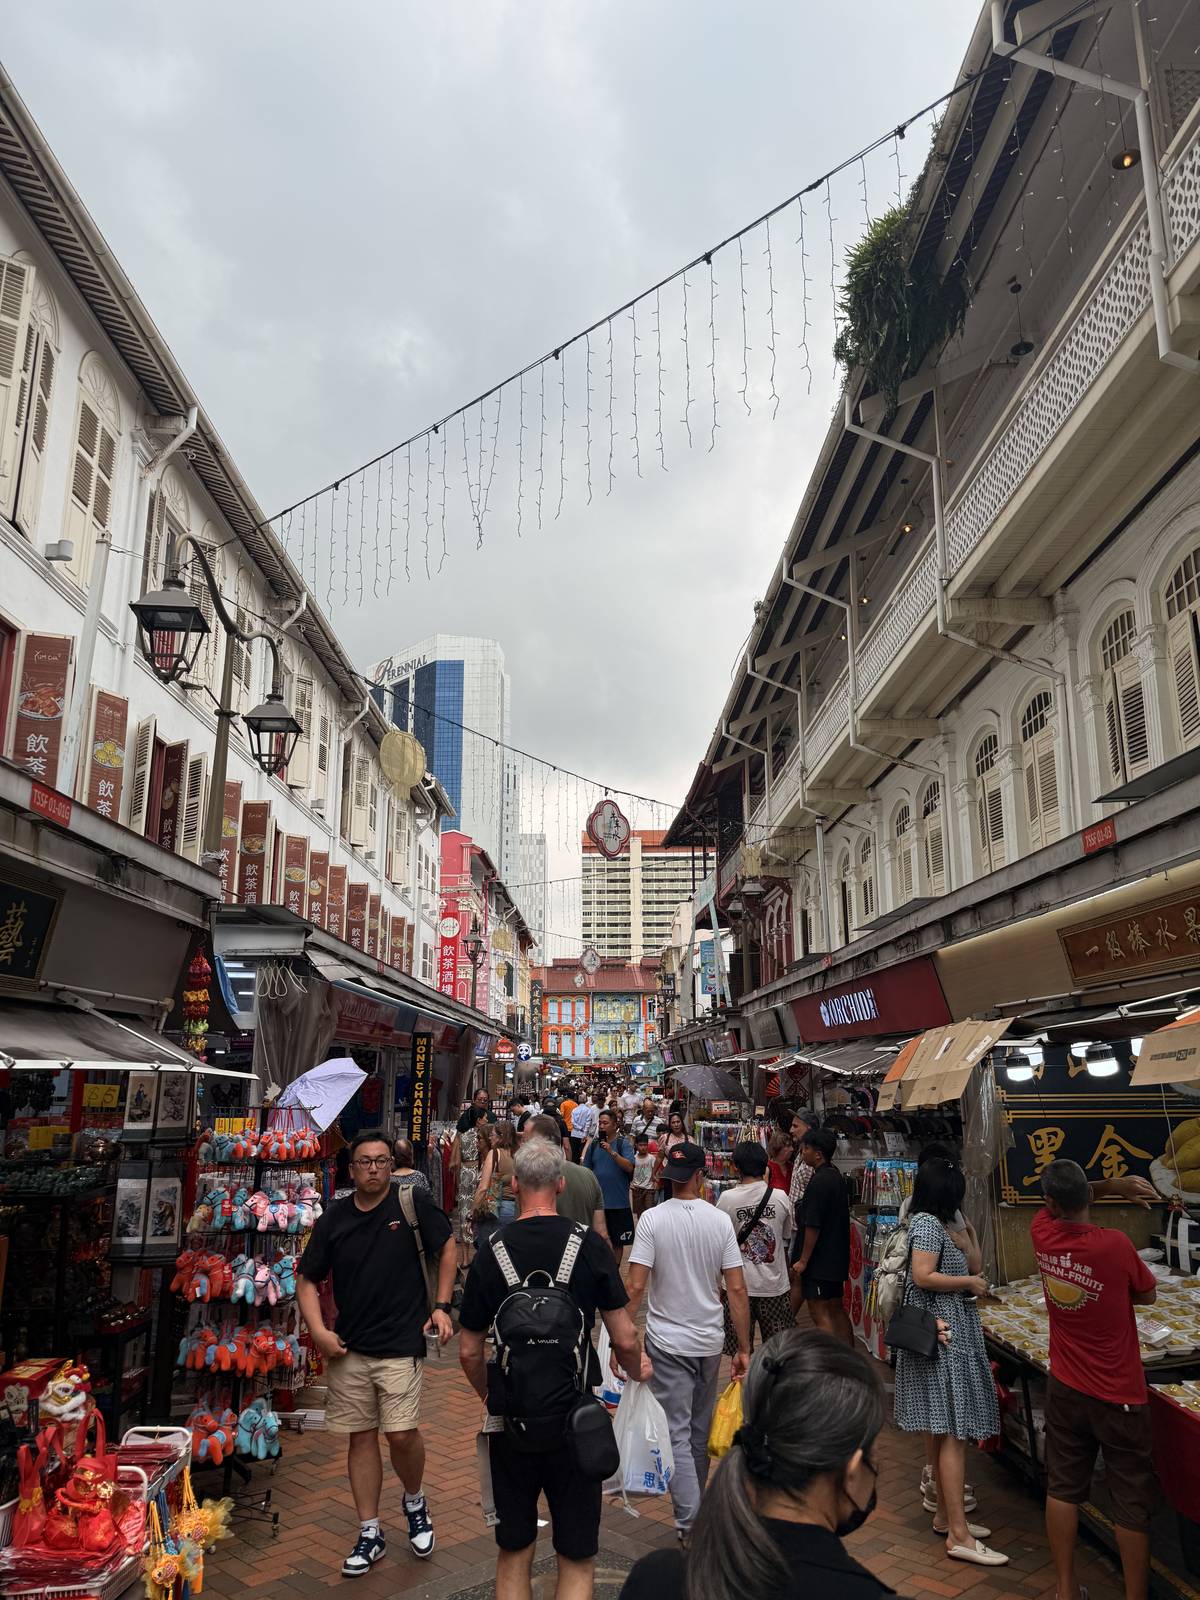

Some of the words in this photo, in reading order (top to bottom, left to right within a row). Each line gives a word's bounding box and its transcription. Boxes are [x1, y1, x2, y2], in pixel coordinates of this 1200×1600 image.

[375, 655, 427, 685] PERENNIAL
[33, 789, 48, 808] TSSF
[96, 779, 114, 818] 飲茶
[162, 818, 173, 849] 飲茶
[1085, 831, 1097, 848] TSSF
[288, 890, 300, 914] 飲茶
[441, 945, 455, 995] 飲茶酒樓
[828, 991, 871, 1026] ORCHID
[416, 1037, 427, 1078] MONEY
[412, 1082, 424, 1141] CHANGER
[620, 1231, 632, 1241] 47
